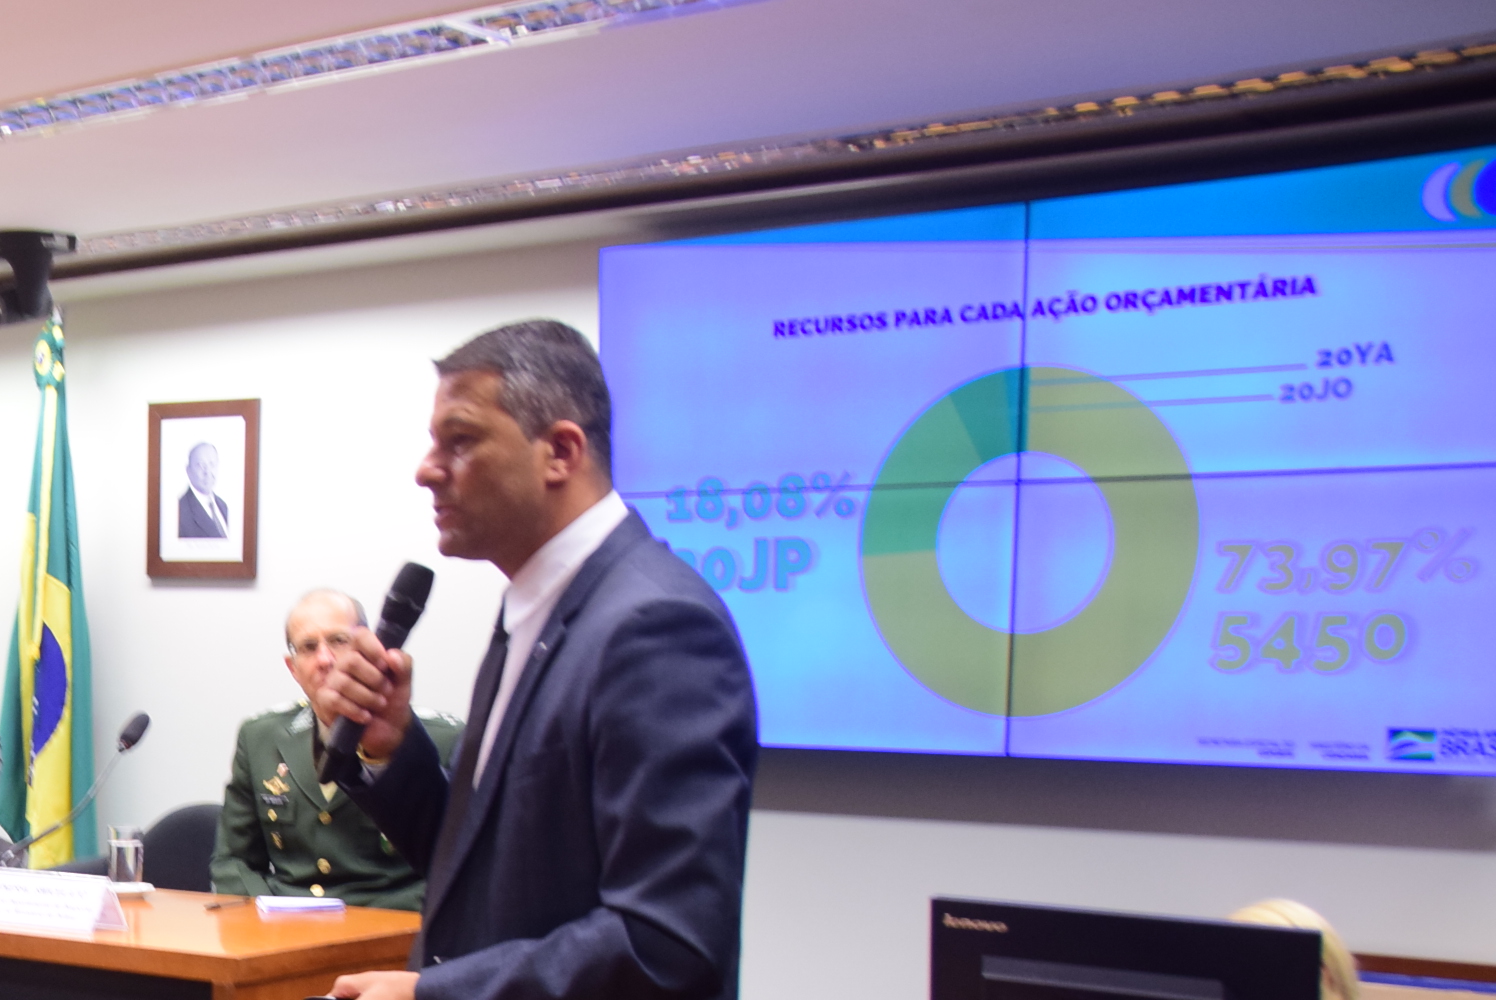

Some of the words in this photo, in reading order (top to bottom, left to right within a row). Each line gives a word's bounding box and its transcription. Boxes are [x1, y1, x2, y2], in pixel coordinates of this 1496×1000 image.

[772, 311, 888, 339] RECURSOS
[894, 305, 954, 328] PARA
[959, 299, 1025, 323] CADA
[1031, 290, 1098, 322] AÇÃO
[1104, 273, 1317, 315] ORÇAMENTÁRIA
[1315, 340, 1395, 370] 20YA
[665, 470, 858, 530] 18,08%
[1215, 526, 1481, 595] 73,97%
